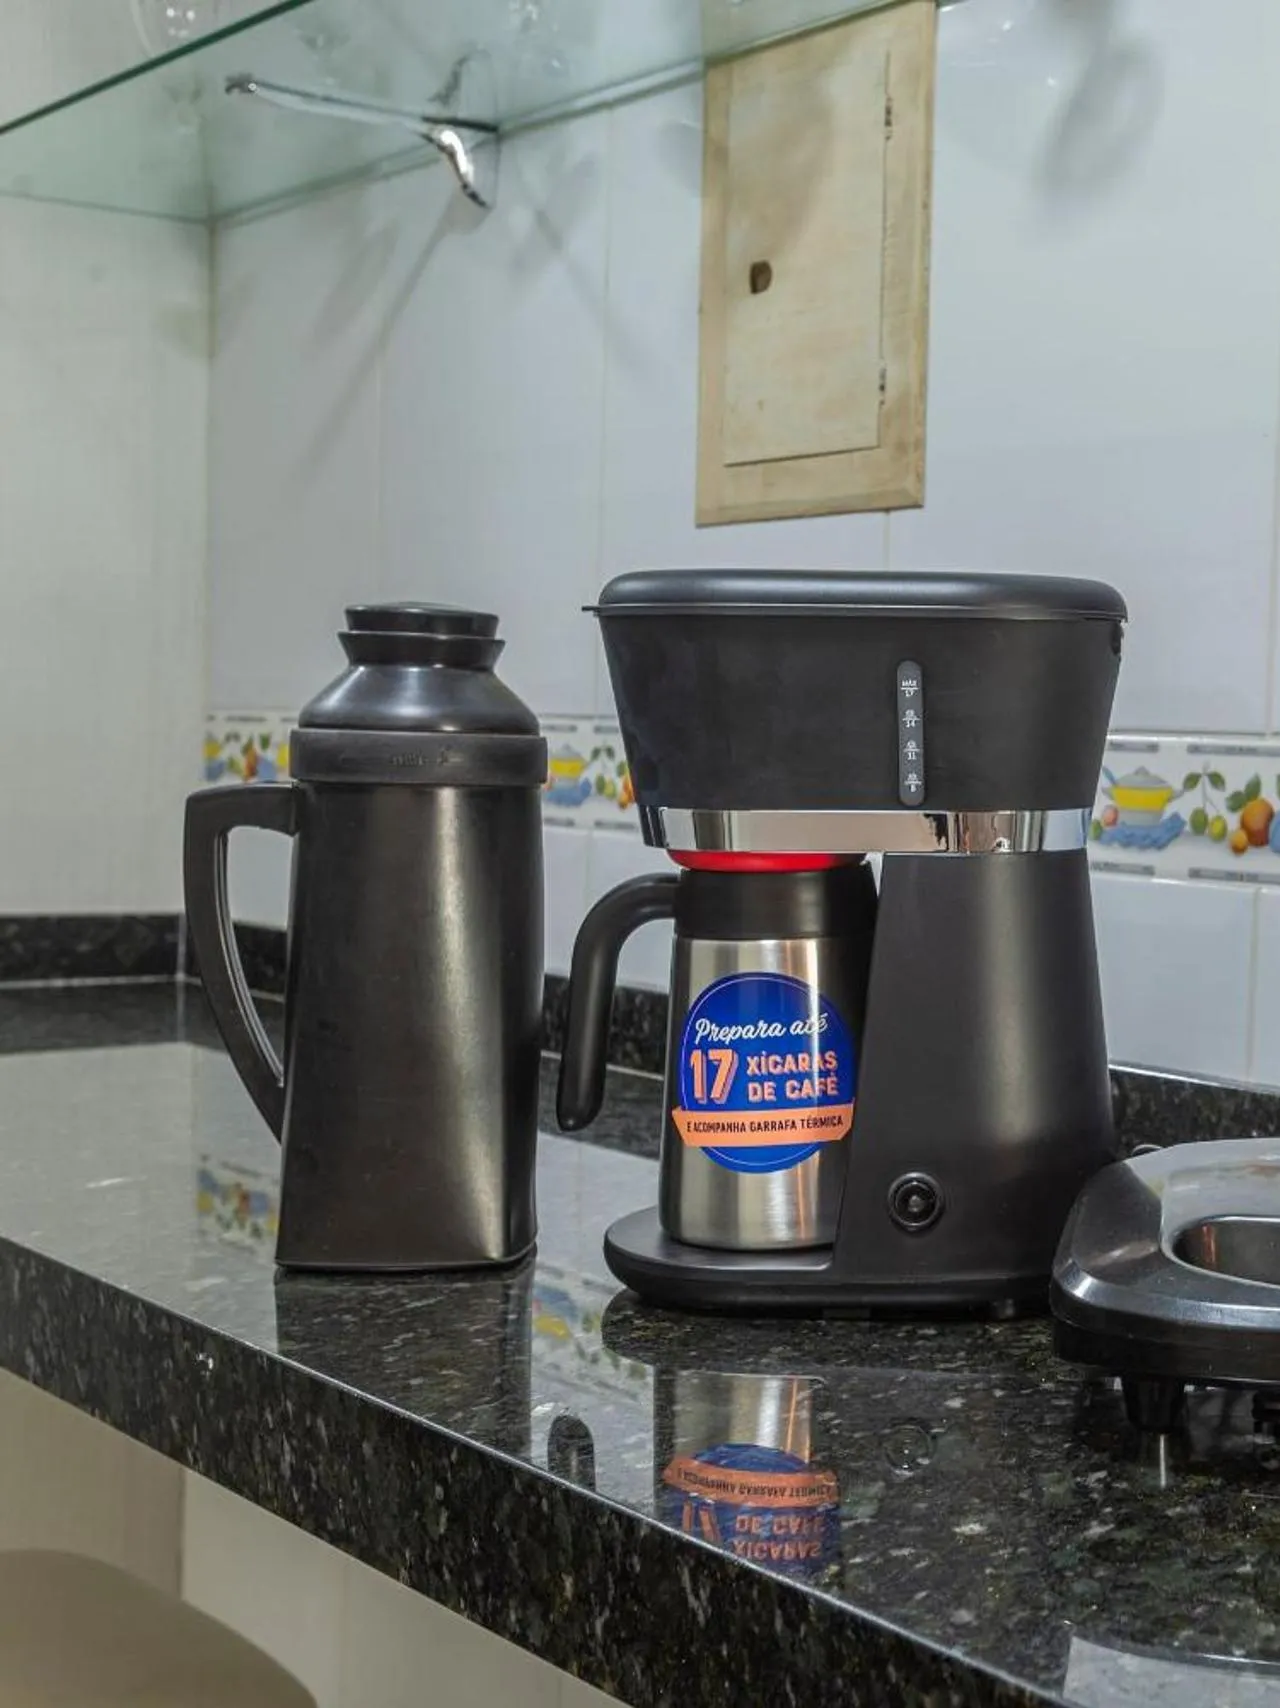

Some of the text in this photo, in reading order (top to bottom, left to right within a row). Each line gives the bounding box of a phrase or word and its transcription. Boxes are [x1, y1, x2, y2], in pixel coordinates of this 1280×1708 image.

[694, 1012, 829, 1045] Prepara até
[690, 1048, 739, 1105] 17
[746, 1051, 839, 1076] XÍCARAS
[747, 1072, 839, 1103] DE CAFÉ
[692, 1120, 747, 1134] ACOMPANHA
[749, 1118, 798, 1133] GARRAFA
[800, 1115, 844, 1130] TÉRMICA
